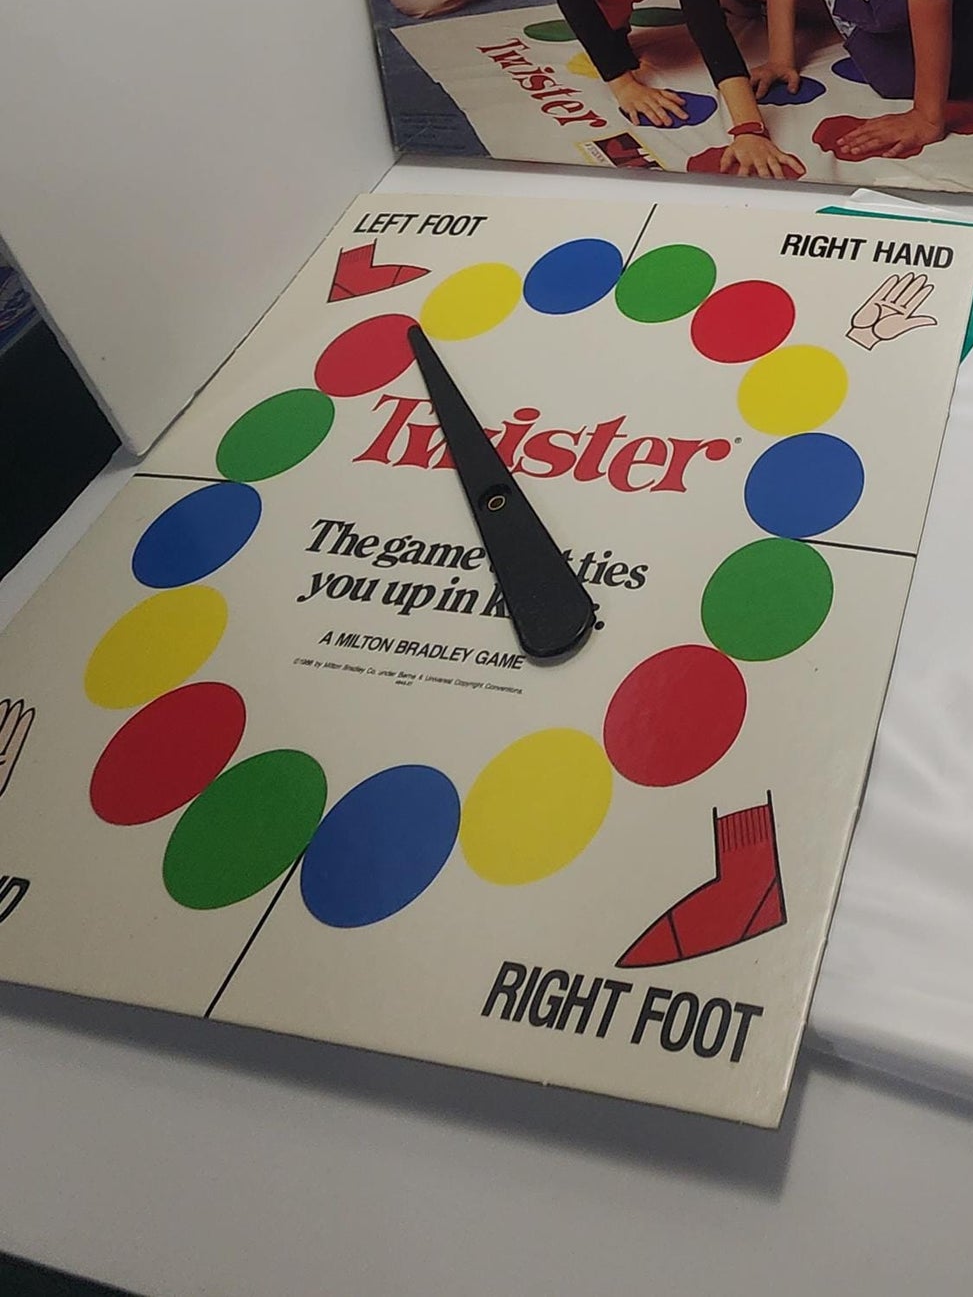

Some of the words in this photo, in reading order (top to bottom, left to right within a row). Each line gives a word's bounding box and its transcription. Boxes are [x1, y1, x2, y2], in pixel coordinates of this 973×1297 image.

[476, 37, 607, 130] Twister
[353, 213, 419, 234] LEFT
[416, 214, 488, 236] FOOT
[780, 233, 867, 260] RIGHT
[872, 240, 954, 269] HAND
[305, 517, 380, 560] The
[371, 534, 487, 570] game
[574, 550, 651, 590] ties
[296, 571, 380, 603] you
[381, 582, 436, 616] up
[436, 576, 480, 615] in
[318, 630, 333, 645] A
[334, 632, 395, 652] MILTON
[394, 640, 474, 663] BRADLEY
[474, 650, 526, 670] GAME
[480, 960, 634, 1039] RIGHT
[630, 986, 764, 1063] FOOT
